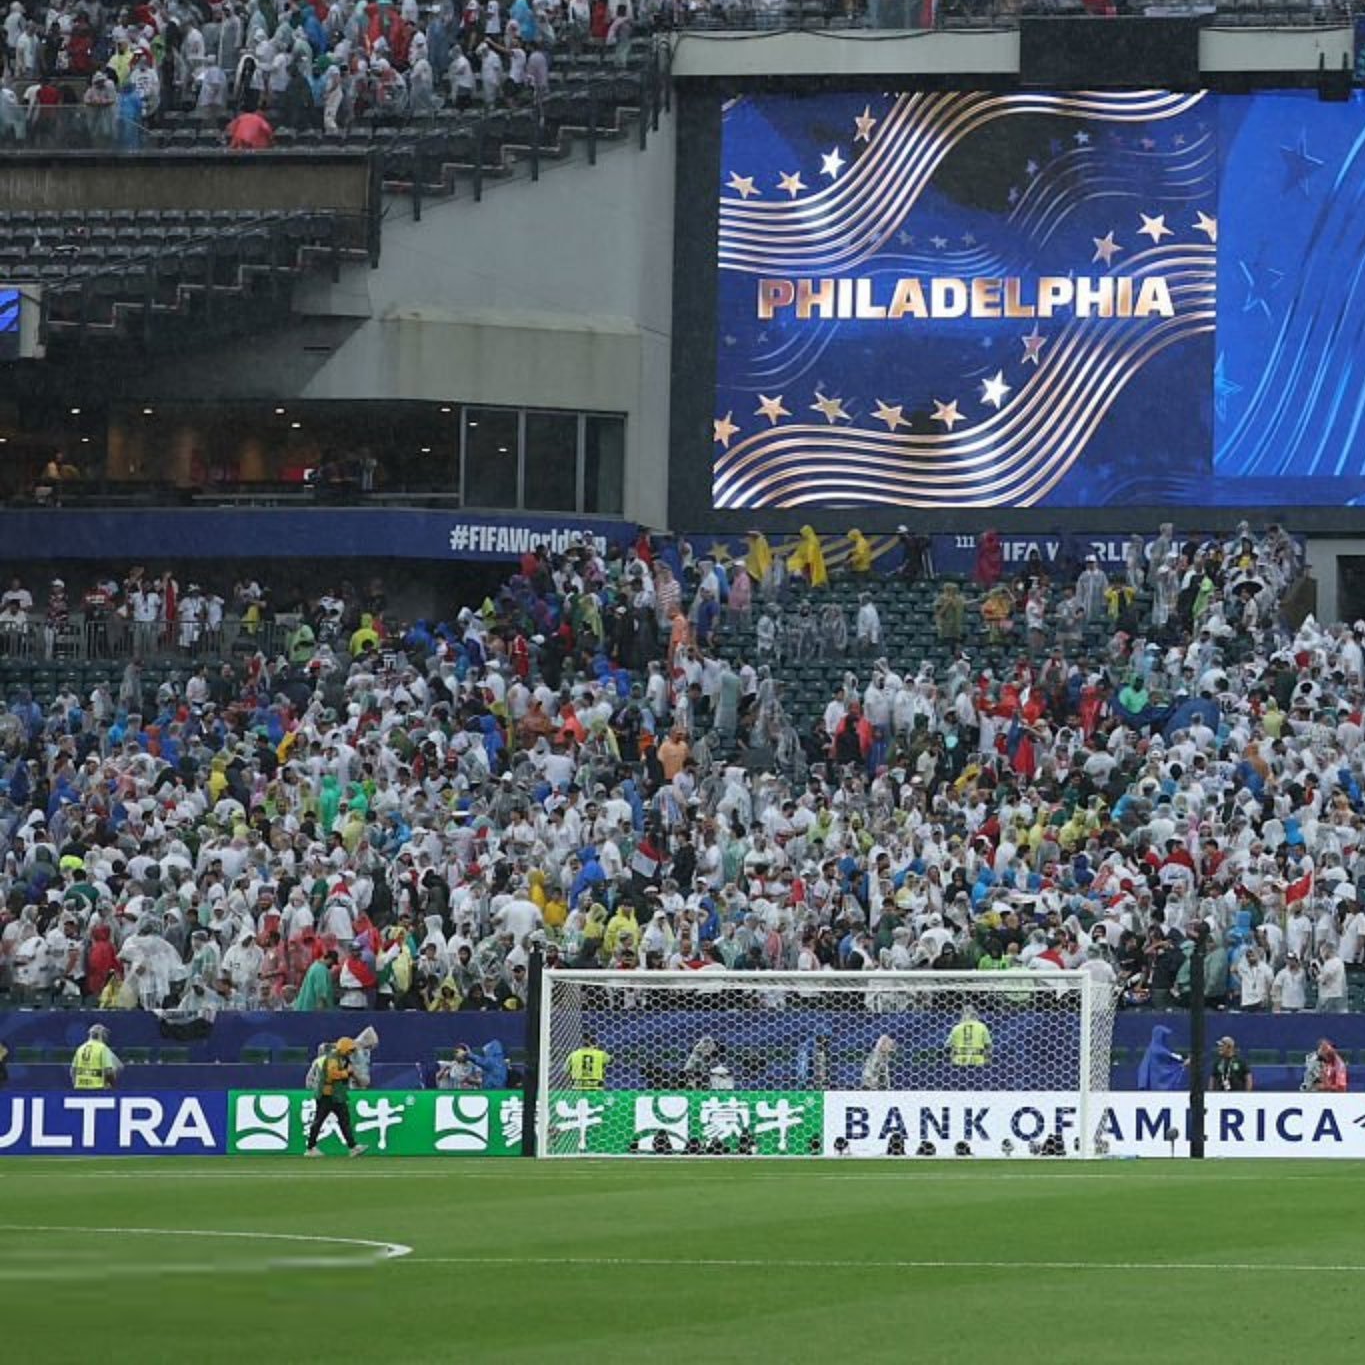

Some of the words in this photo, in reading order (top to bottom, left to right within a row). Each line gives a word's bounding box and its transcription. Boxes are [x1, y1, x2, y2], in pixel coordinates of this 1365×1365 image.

[757, 277, 1176, 319] PHILADELPHIA
[844, 1105, 991, 1141] BANK
[1010, 1105, 1078, 1142] OF
